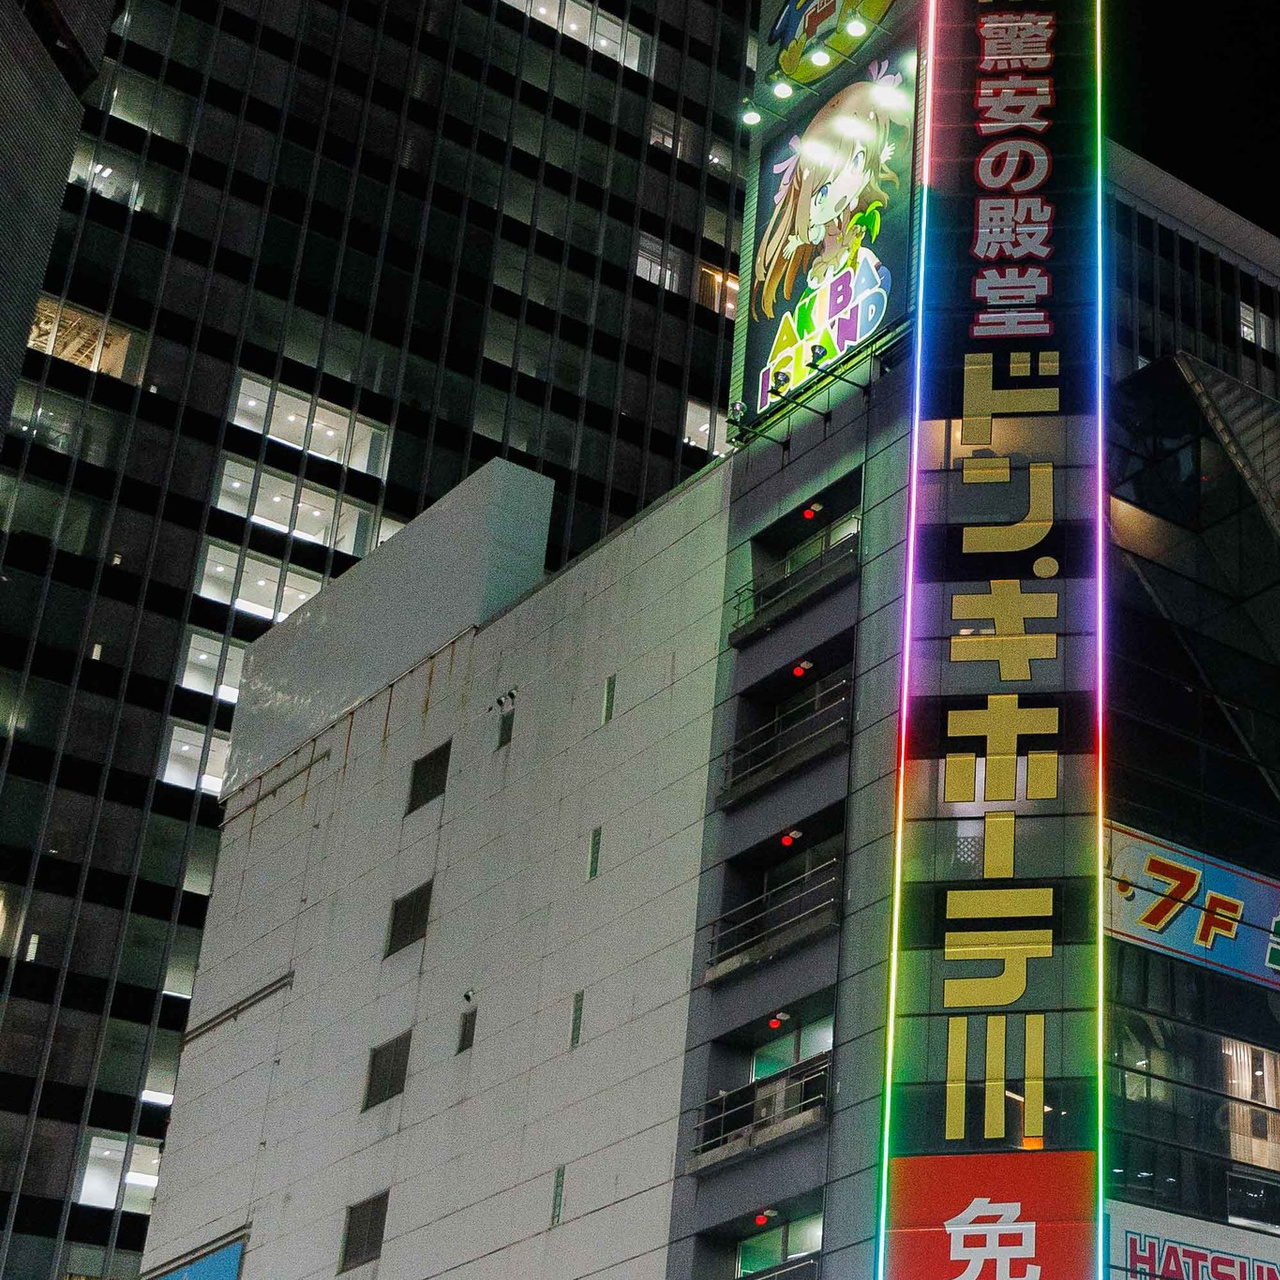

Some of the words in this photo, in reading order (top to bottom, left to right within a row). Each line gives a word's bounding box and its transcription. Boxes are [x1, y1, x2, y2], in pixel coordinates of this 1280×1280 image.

[971, 11, 1056, 339] 驚安の殿堂
[759, 289, 887, 410] ISLAND
[768, 257, 880, 367] AKIBA
